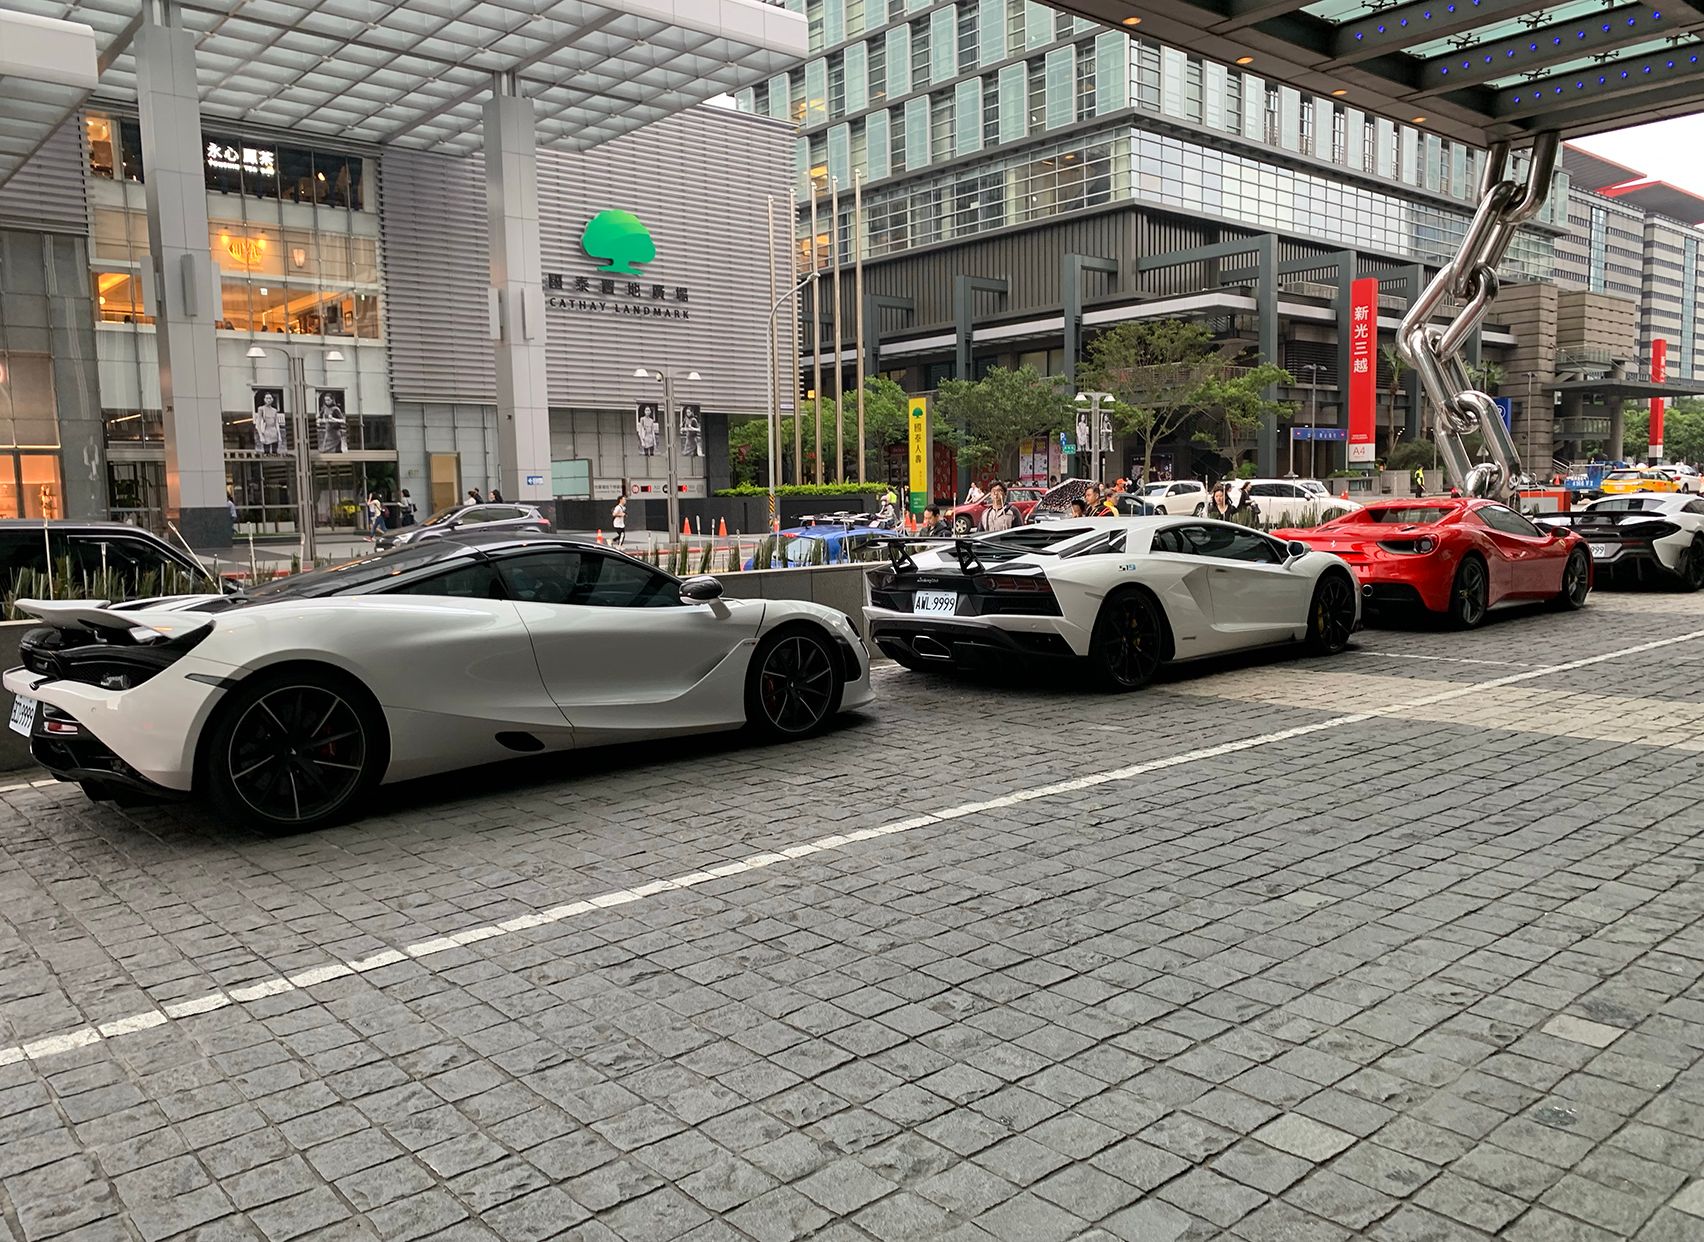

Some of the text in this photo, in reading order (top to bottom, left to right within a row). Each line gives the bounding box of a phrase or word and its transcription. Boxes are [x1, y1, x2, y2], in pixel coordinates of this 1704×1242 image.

[549, 297, 690, 319] CATHAY LANDMARK
[1353, 305, 1369, 374] 新光三越
[1353, 447, 1366, 456] A4
[915, 597, 956, 611] AWL-9999
